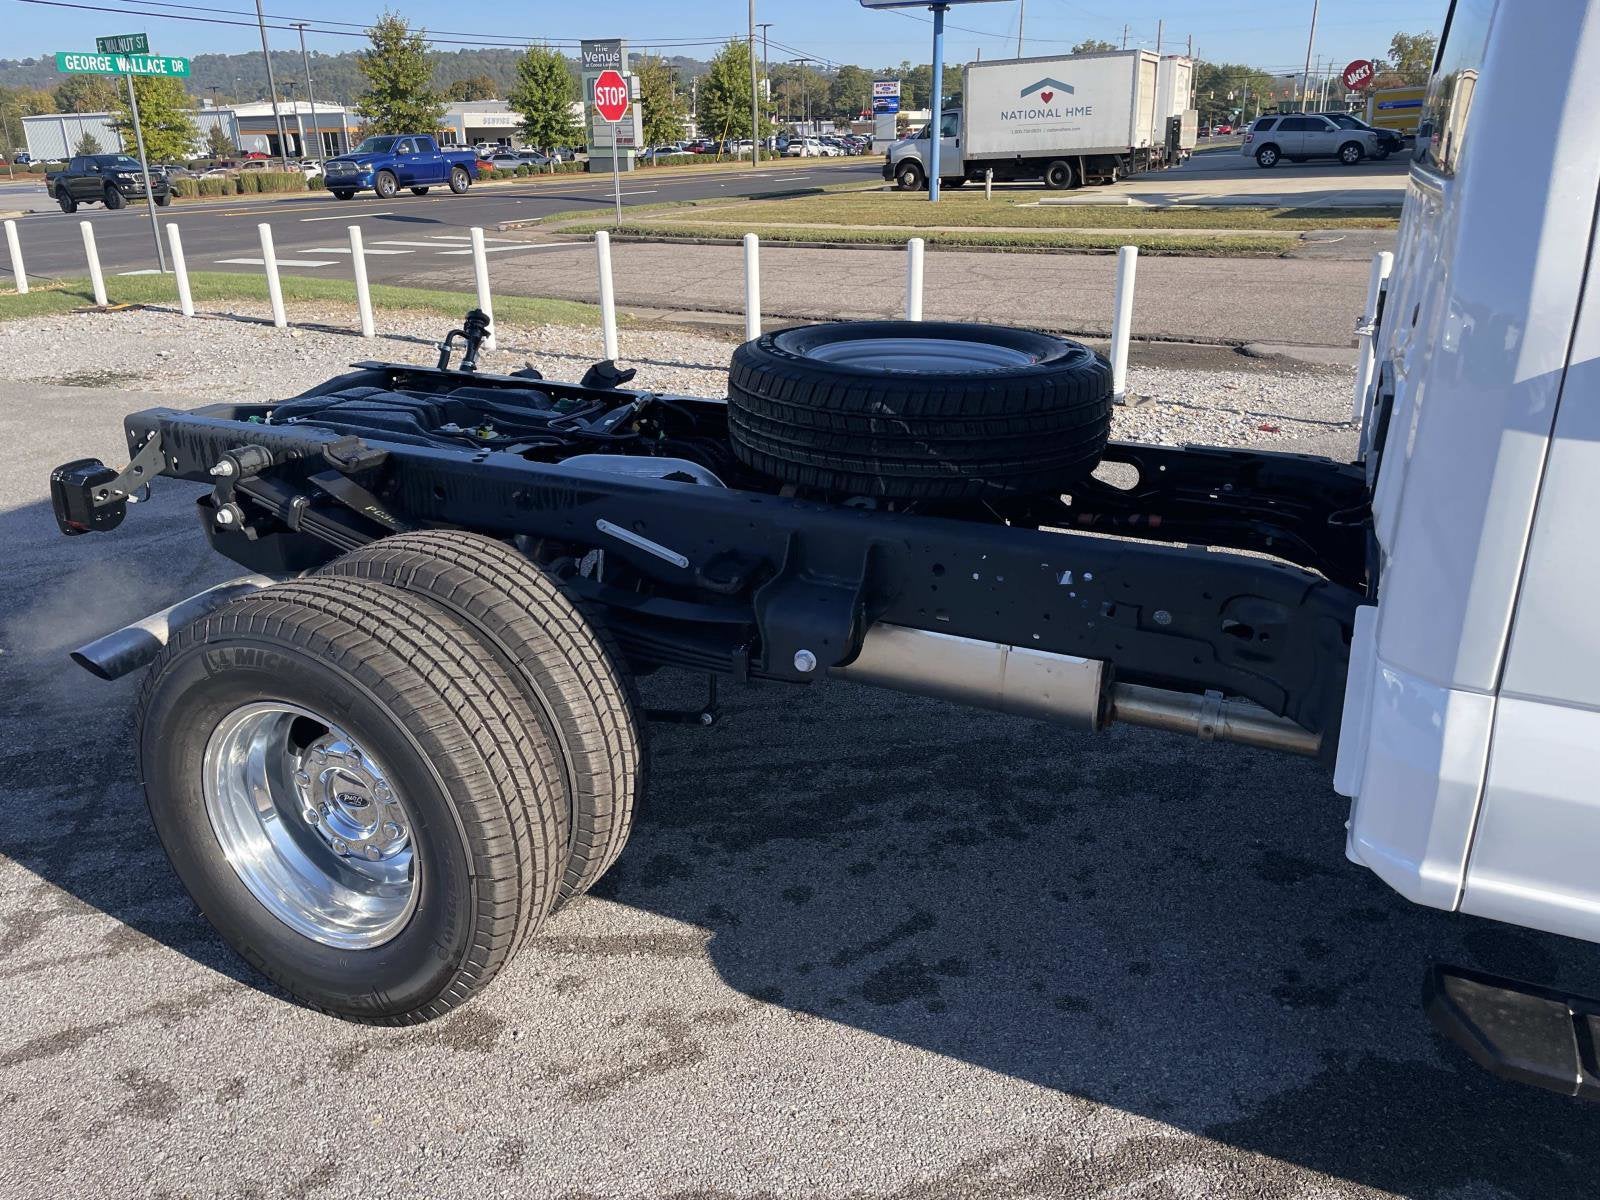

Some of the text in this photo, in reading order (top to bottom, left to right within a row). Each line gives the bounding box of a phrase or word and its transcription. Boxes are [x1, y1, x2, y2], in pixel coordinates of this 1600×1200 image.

[105, 37, 134, 54] WALNUT
[136, 36, 145, 49] ST
[593, 44, 609, 52] The
[583, 51, 620, 62] Venue
[65, 55, 185, 74] GEORGE WALLACE DR
[596, 86, 626, 106] STOP
[1000, 106, 1093, 121] NATIONAL HME
[343, 793, 364, 806] Ford
